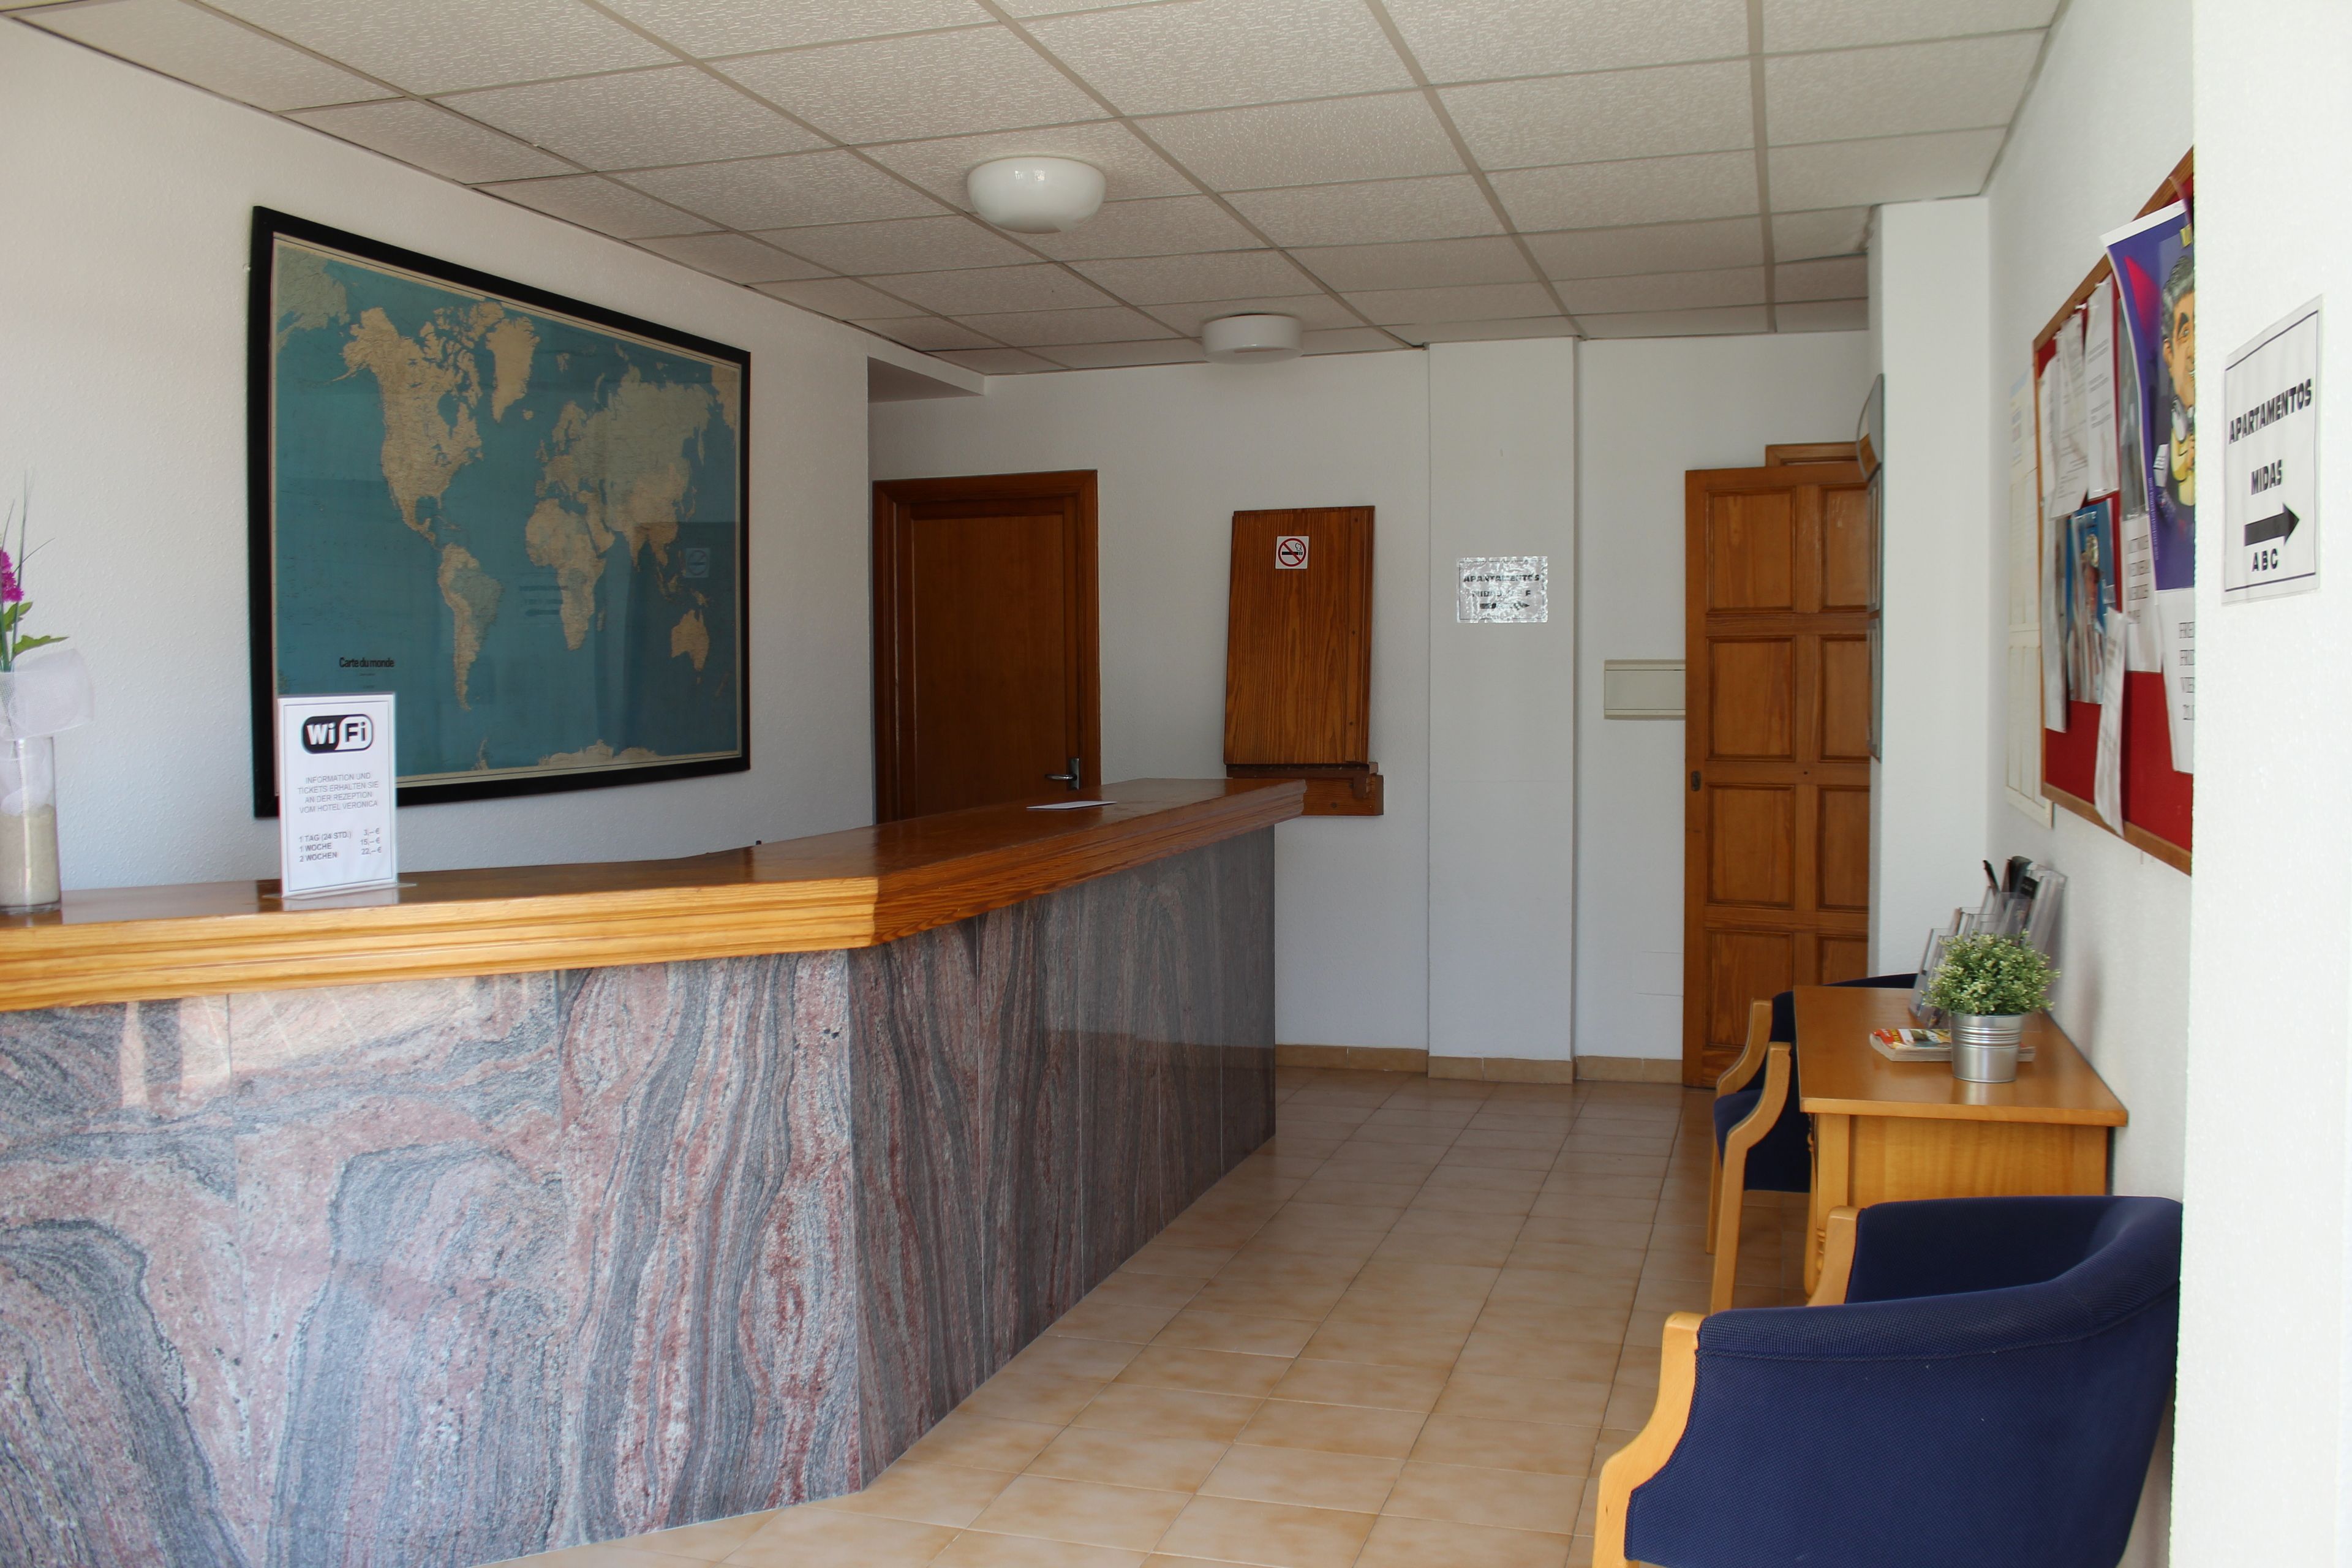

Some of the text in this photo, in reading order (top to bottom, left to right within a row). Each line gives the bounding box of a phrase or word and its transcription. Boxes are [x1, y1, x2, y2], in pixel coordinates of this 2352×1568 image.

[2228, 378, 2312, 445] APARTAMENTOS
[2250, 459, 2282, 496] MIDAS
[339, 657, 395, 668] Carte du monde
[305, 774, 355, 785] INFORMATION
[298, 781, 379, 795] TICKETS ERHALTEN SIE
[316, 794, 332, 803] DER
[333, 791, 372, 801] REZEPTION
[299, 800, 379, 814] VOM HOTEL VERONICA
[321, 833, 332, 842] (24
[304, 842, 333, 852] WOCHE
[305, 851, 338, 861] WOCHEN
